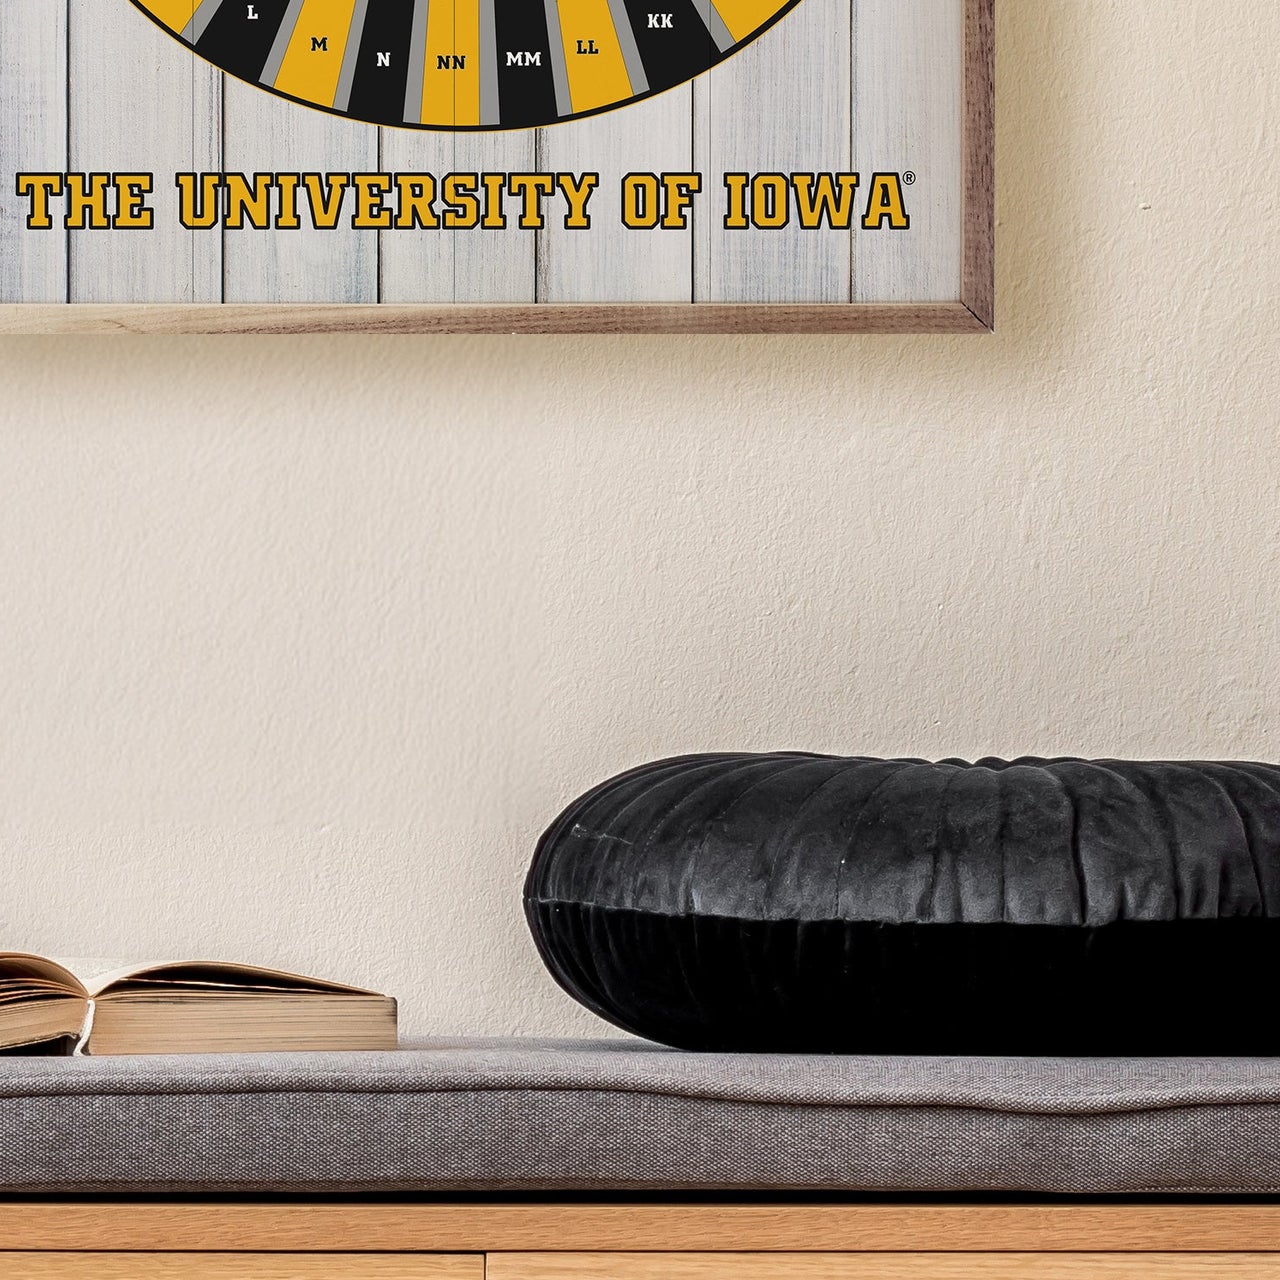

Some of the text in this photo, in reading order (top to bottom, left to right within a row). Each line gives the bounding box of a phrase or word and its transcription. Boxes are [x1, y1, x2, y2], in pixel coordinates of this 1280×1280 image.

[247, 4, 259, 20] L
[647, 13, 674, 29] KK
[311, 36, 328, 52] M
[576, 39, 599, 55] LL
[376, 51, 391, 67] N
[436, 54, 466, 70] NN
[505, 51, 543, 67] MM
[16, 172, 154, 230] THE
[175, 172, 599, 230] UNIVERSITY
[621, 172, 702, 230] OF
